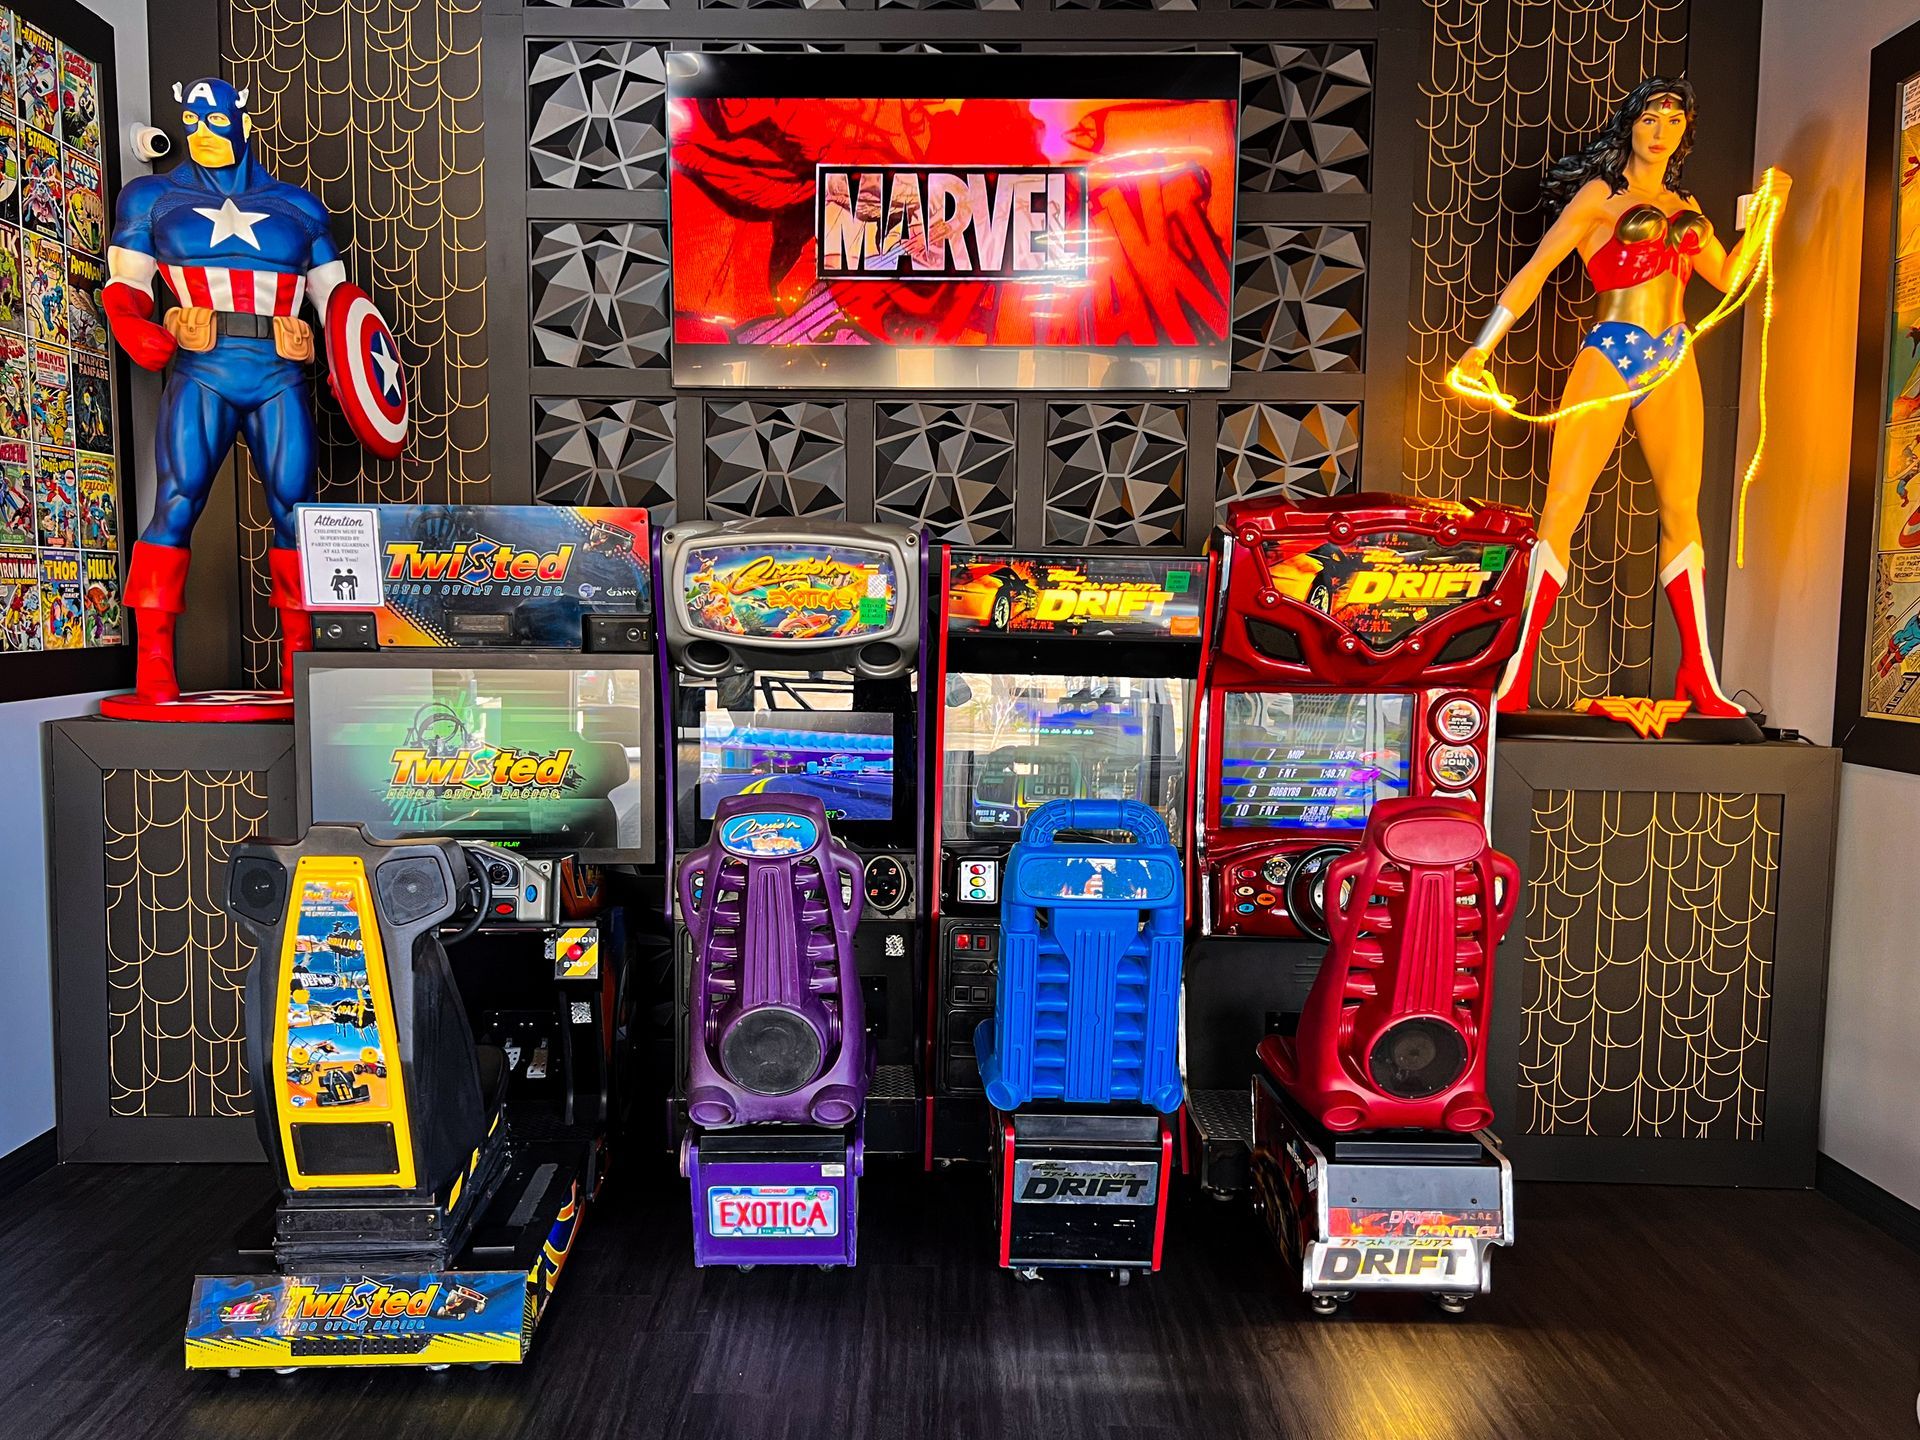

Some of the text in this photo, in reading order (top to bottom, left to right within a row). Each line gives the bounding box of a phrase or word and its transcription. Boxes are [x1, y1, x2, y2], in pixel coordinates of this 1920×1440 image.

[187, 82, 217, 106] A
[28, 131, 59, 160] STRANGE
[70, 158, 98, 180] IRON
[72, 172, 98, 191] FIST
[823, 173, 1073, 271] MARVEL
[37, 350, 66, 367] MARVEL
[79, 353, 107, 369] MARVEL
[79, 363, 109, 380] FANFARE
[314, 515, 363, 527] Attention
[88, 558, 117, 580] HULK
[384, 535, 576, 585] Twisted
[20, 562, 37, 579] MAN
[45, 560, 78, 580] THOR
[729, 554, 850, 595] Cruis'n
[441, 585, 493, 596] STUNT
[502, 585, 564, 596] RACING
[1347, 571, 1492, 604] DRIFT
[767, 588, 852, 610] EXOTICA
[1035, 589, 1174, 621] DRIFT
[1267, 748, 1276, 760] 7
[1440, 758, 1469, 766] NOW!
[388, 743, 575, 790] Twisted
[1258, 766, 1267, 779] 8
[1278, 768, 1298, 778] FNF
[386, 788, 560, 800] NITRO STUNT RACING
[1248, 785, 1257, 797] 9
[1235, 804, 1250, 816] 10
[1259, 805, 1280, 816] FNF
[729, 817, 801, 843] Cruis'n
[871, 867, 897, 876] 1 3
[1021, 1177, 1149, 1200] DRIFT
[719, 1201, 828, 1227] EXOTICA
[1388, 1210, 1443, 1224] DRIFT
[1415, 1225, 1502, 1239] CONTROL
[1319, 1248, 1468, 1281] DRIFT
[283, 1278, 442, 1321] Twisted
[373, 1320, 426, 1330] RACING
